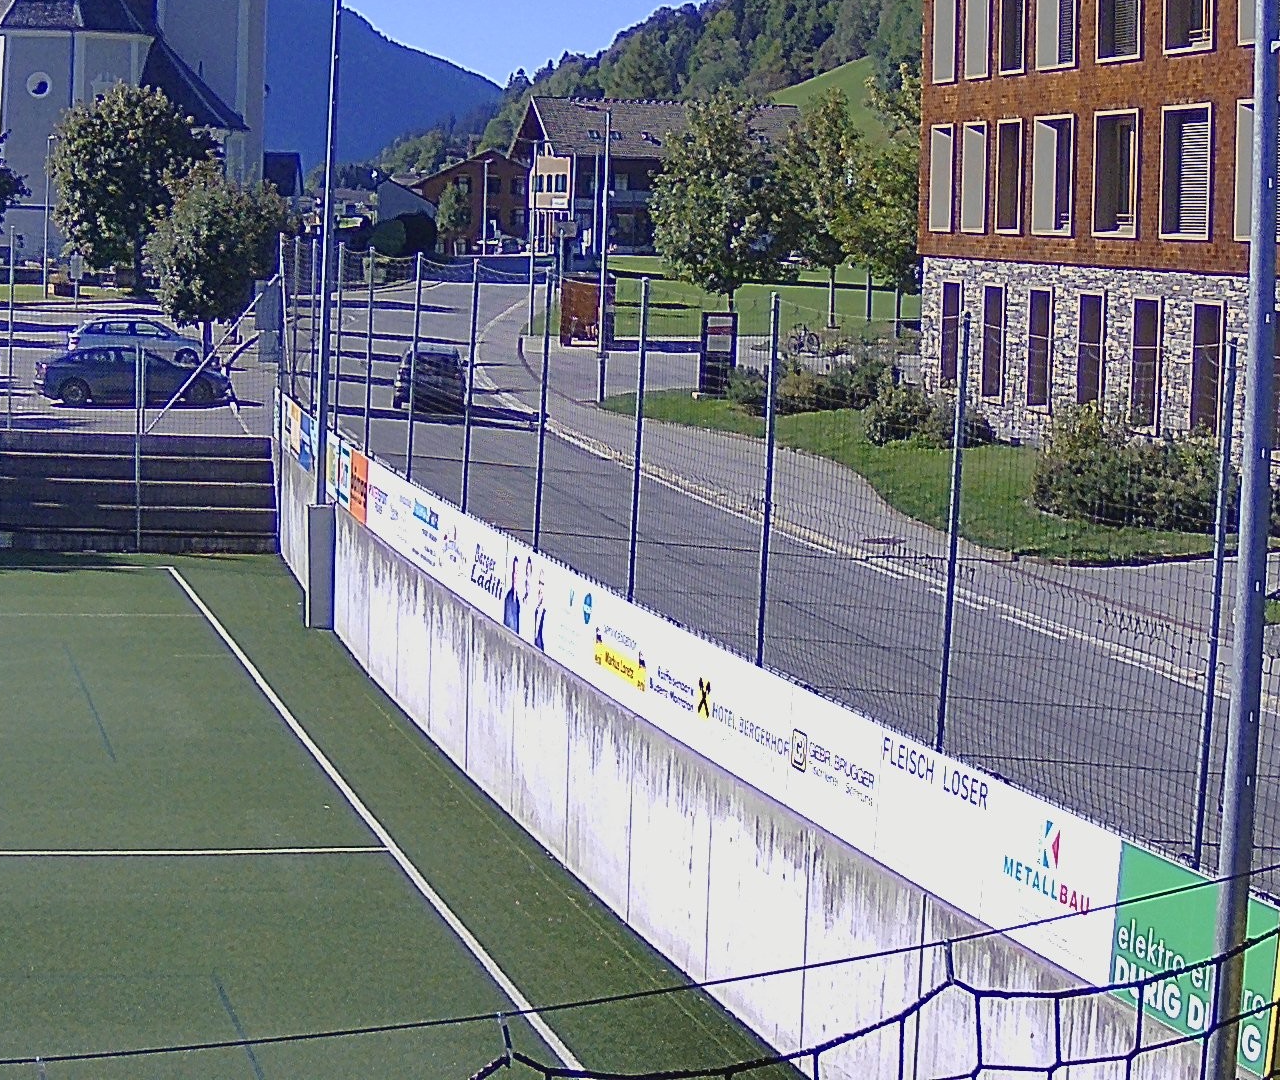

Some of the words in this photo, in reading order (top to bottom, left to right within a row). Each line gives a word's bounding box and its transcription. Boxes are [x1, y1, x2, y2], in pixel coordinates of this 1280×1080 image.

[882, 736, 935, 784] FLEISCH
[943, 765, 989, 810] LOSER
[1003, 854, 1090, 915] METALLBAU
[1118, 918, 1186, 972] elektro
